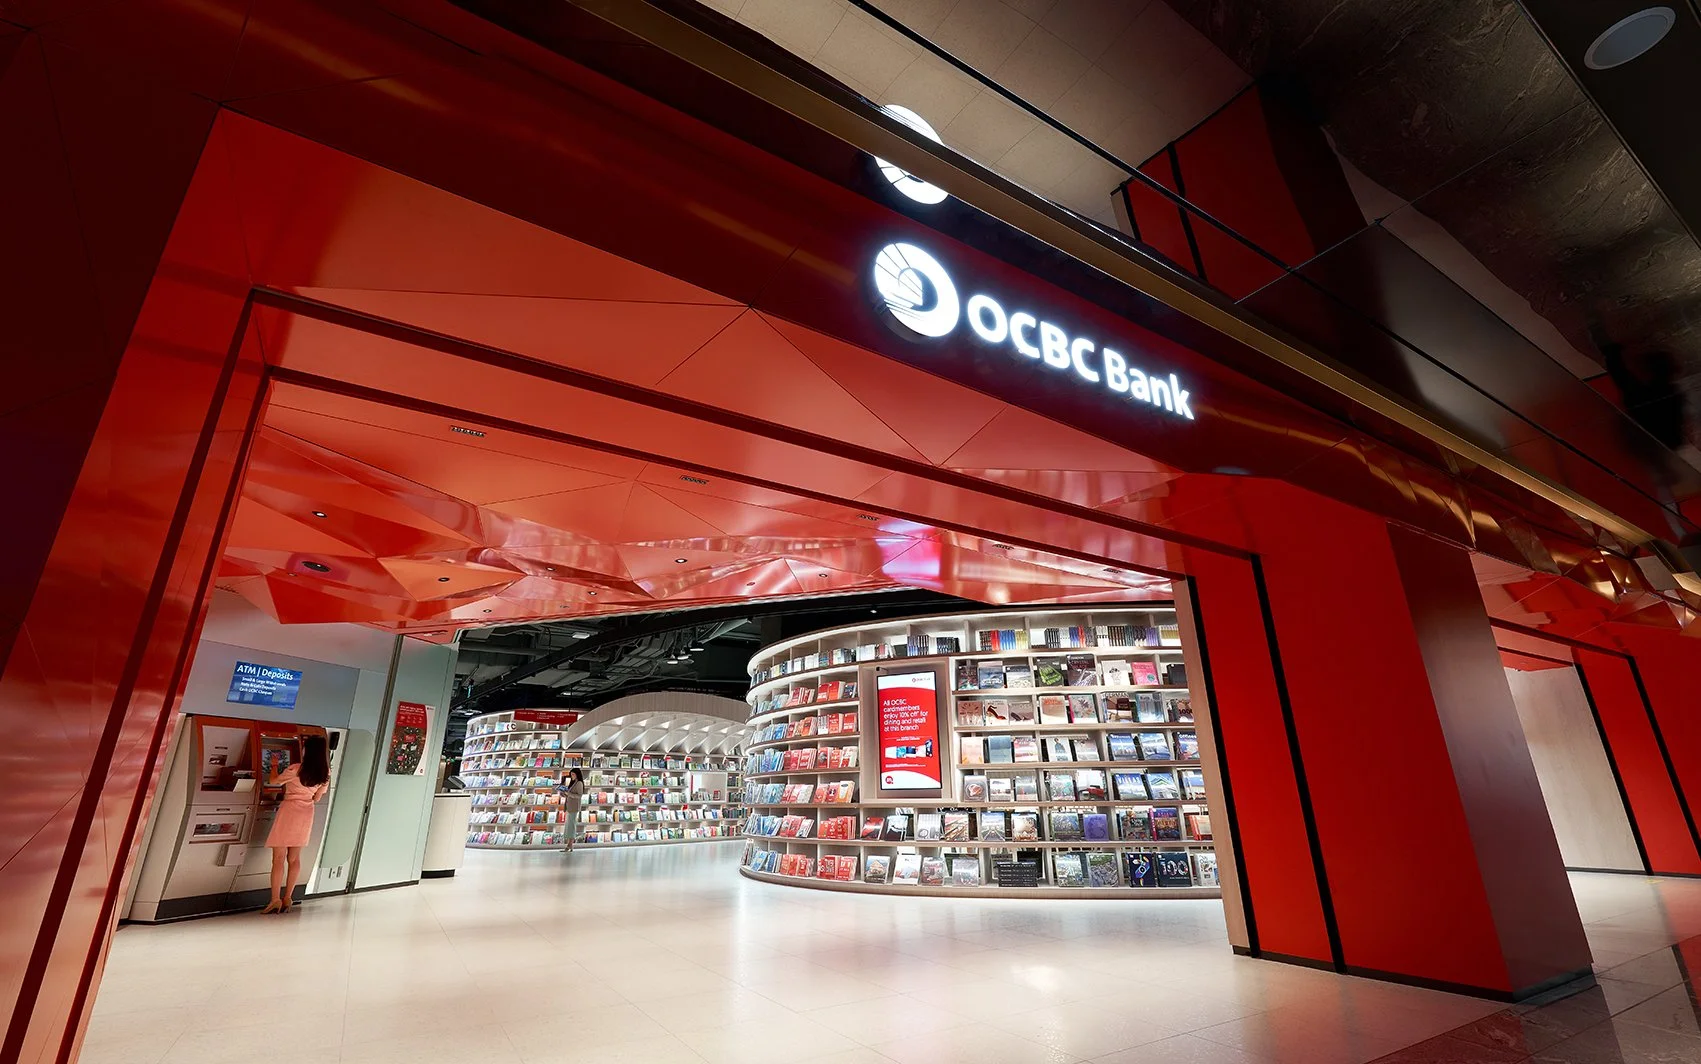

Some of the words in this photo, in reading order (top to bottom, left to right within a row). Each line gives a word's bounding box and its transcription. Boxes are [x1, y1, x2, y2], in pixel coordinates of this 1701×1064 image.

[967, 294, 1100, 384] OCBC
[1104, 347, 1196, 421] Bank
[236, 664, 256, 674] ATM
[262, 668, 294, 680] Deposits
[1160, 860, 1188, 876] 100
